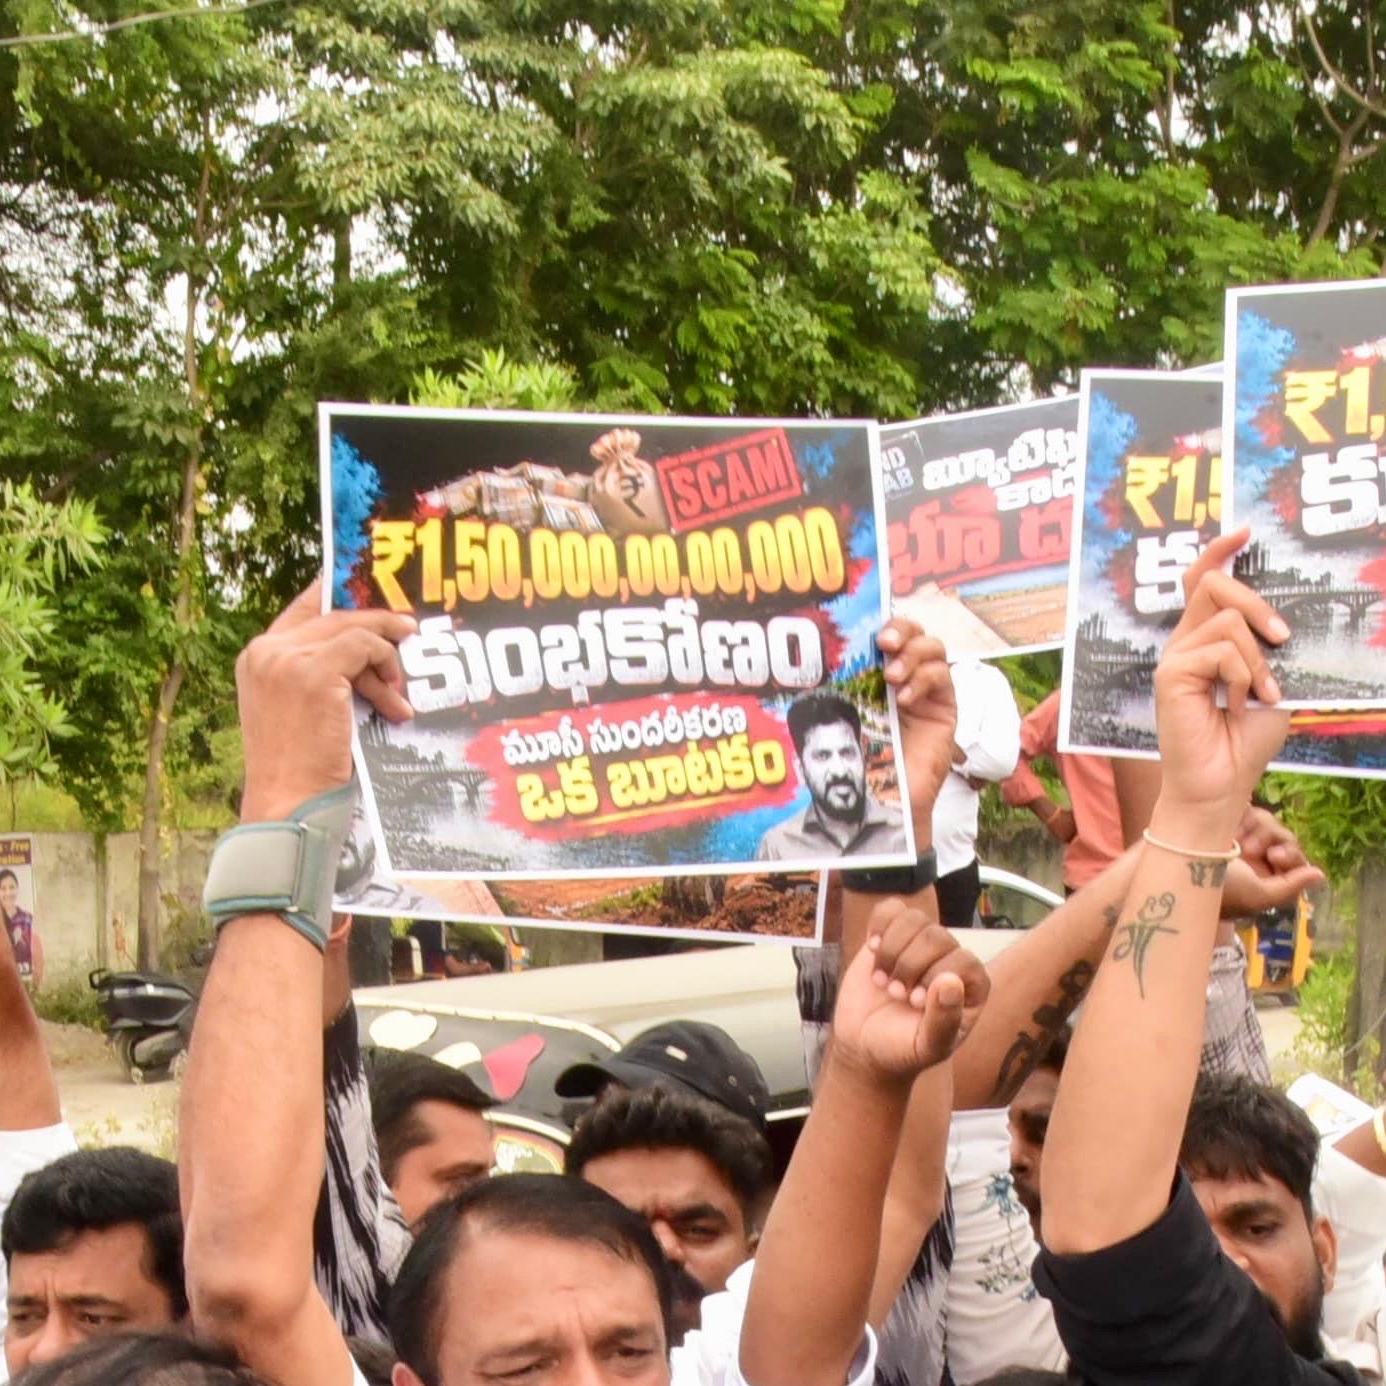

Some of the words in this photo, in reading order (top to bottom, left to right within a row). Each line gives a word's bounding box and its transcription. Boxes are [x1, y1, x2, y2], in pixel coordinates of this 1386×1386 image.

[669, 438, 788, 518] SCAM
[398, 598, 823, 713] కుంభకోణం
[500, 715, 585, 766] మూసీ
[516, 755, 599, 822] ఒక
[607, 732, 786, 808] బూటకం
